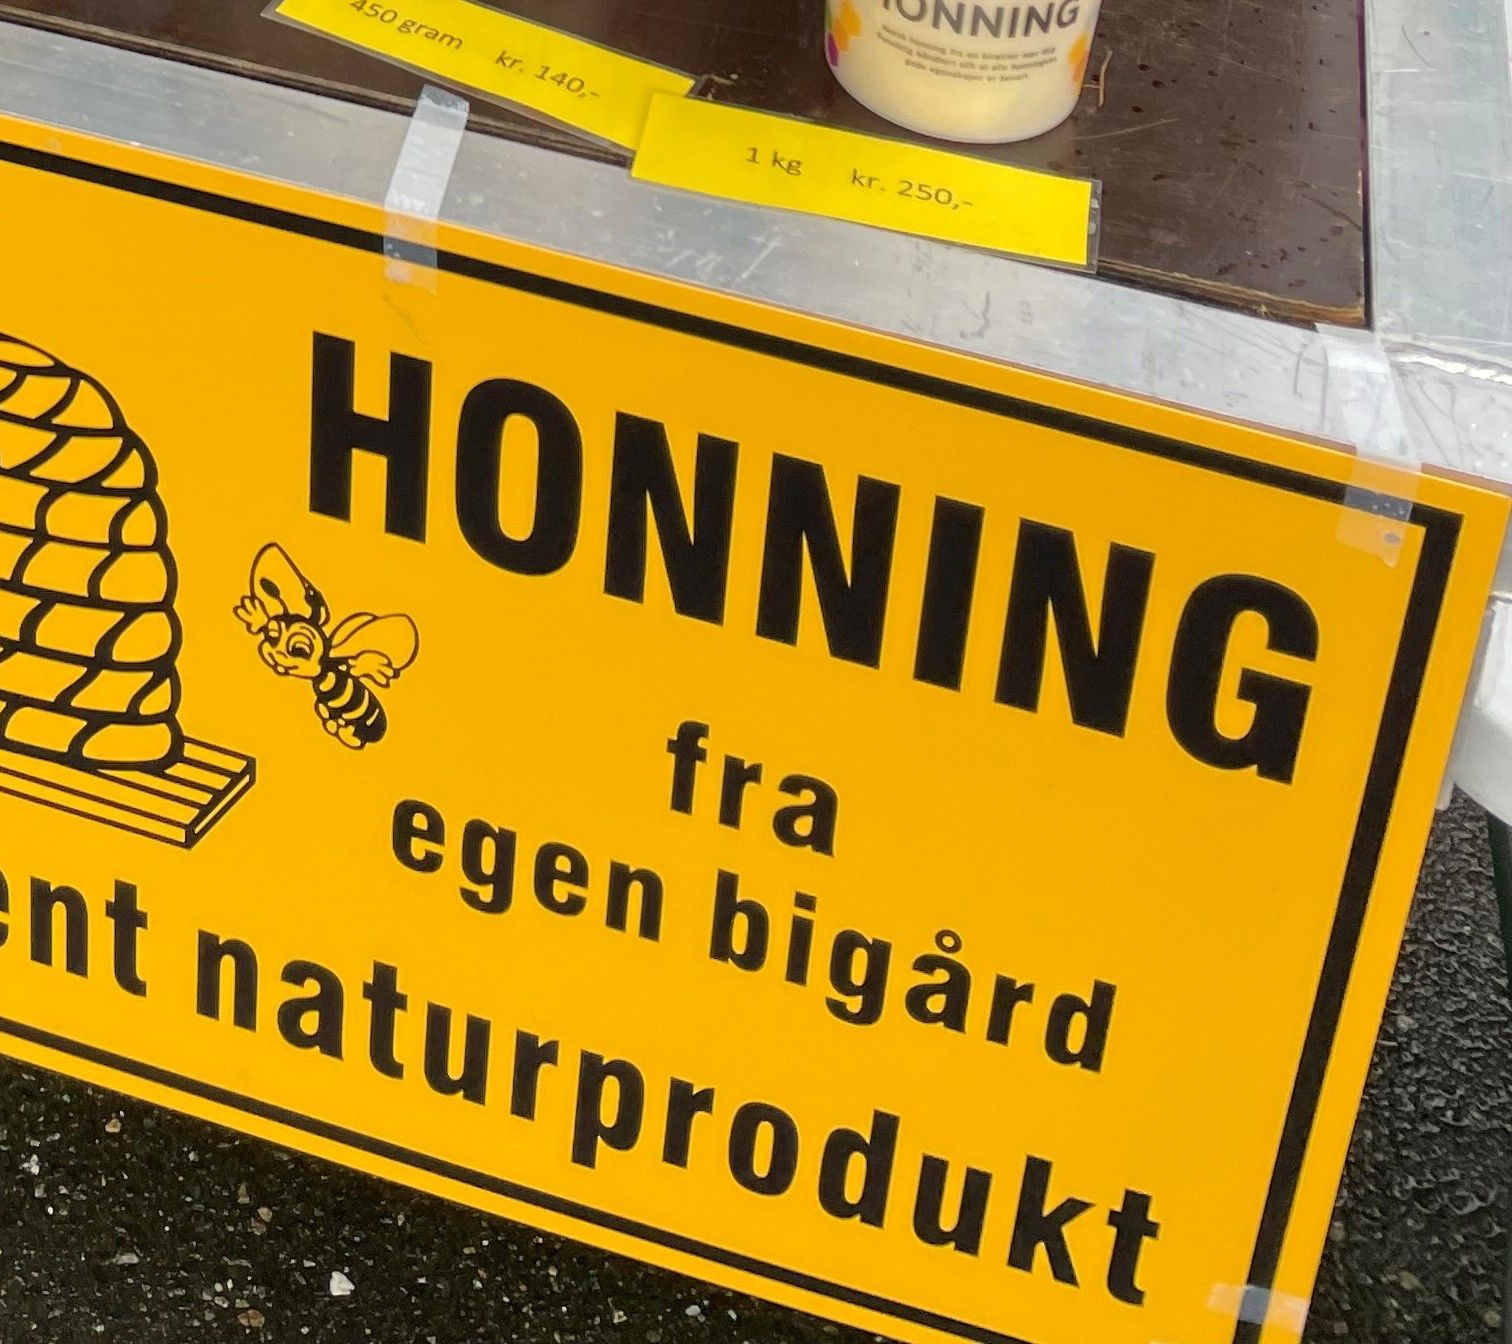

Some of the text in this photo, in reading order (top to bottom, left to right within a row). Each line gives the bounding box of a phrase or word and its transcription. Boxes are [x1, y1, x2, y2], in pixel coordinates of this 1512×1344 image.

[397, 12, 464, 52] gram
[494, 47, 526, 76] kr.
[533, 62, 601, 100] 140,-
[746, 145, 975, 211] 1 kg kr. 250,-
[309, 330, 1320, 786] HONNING
[667, 718, 837, 858] fra
[392, 795, 1116, 1074] egen bigård
[196, 928, 1159, 1308] naturprodukt
